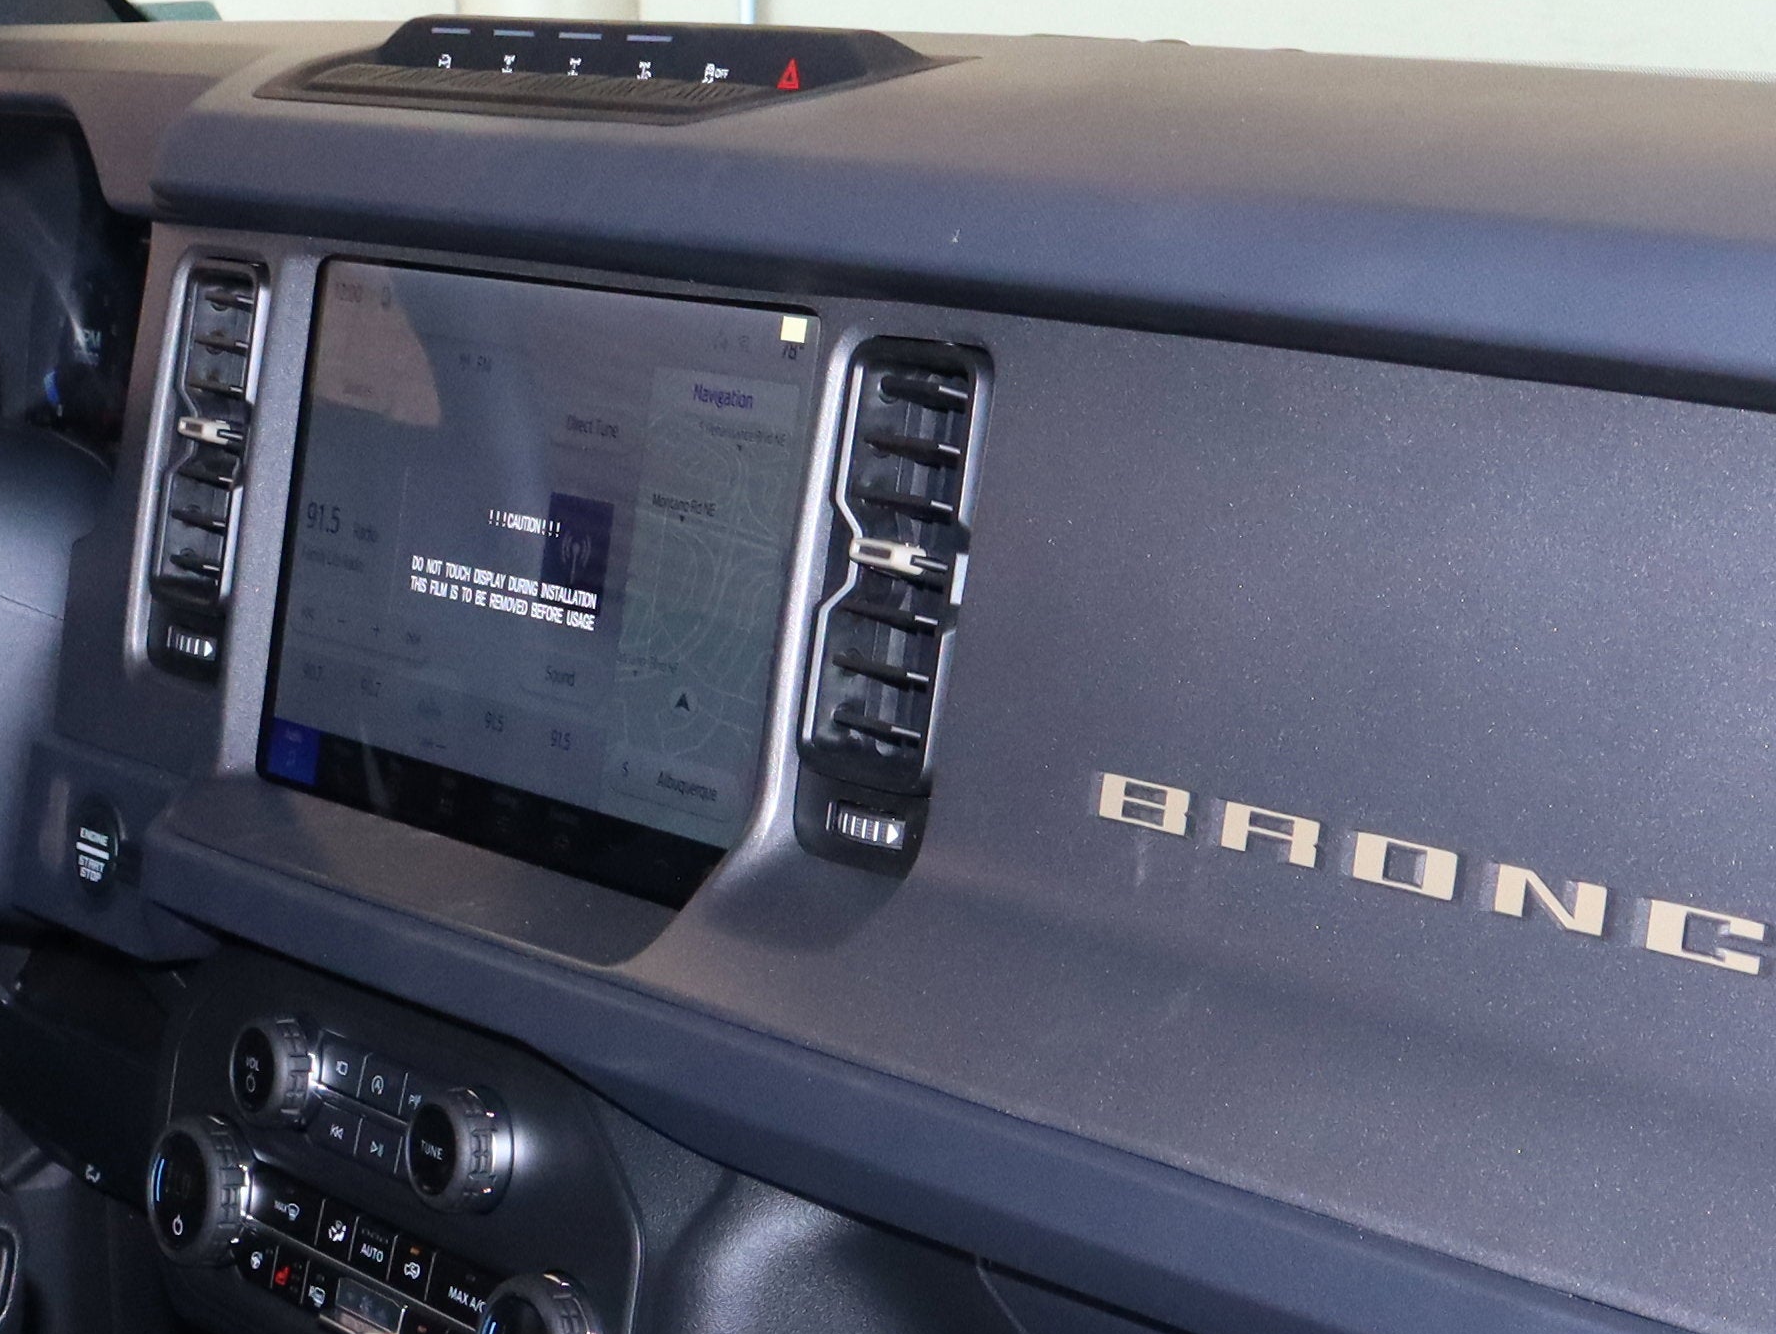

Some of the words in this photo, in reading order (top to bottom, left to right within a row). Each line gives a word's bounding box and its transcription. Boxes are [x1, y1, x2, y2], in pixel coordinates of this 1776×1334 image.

[693, 384, 754, 410] Navigation
[412, 555, 424, 571] DO
[426, 558, 443, 576] NOT
[445, 562, 472, 582] TOUCH
[473, 567, 507, 589] DISPLAY
[508, 575, 539, 597] DURING
[540, 582, 598, 610] INSTALLATION
[411, 575, 427, 593] THIS
[429, 579, 449, 598] FILM
[450, 584, 459, 601] IS
[461, 586, 473, 604] TO
[475, 590, 487, 607] BE
[489, 593, 529, 616] REMOVED
[530, 601, 564, 625] BEFORE
[566, 609, 596, 631] USAGE
[656, 771, 718, 801] Albuquerque
[78, 854, 105, 873] START
[79, 867, 103, 883] STOP
[420, 1139, 444, 1161] TUNE
[360, 1243, 384, 1263] AUTO
[447, 1285, 469, 1308] MAX
